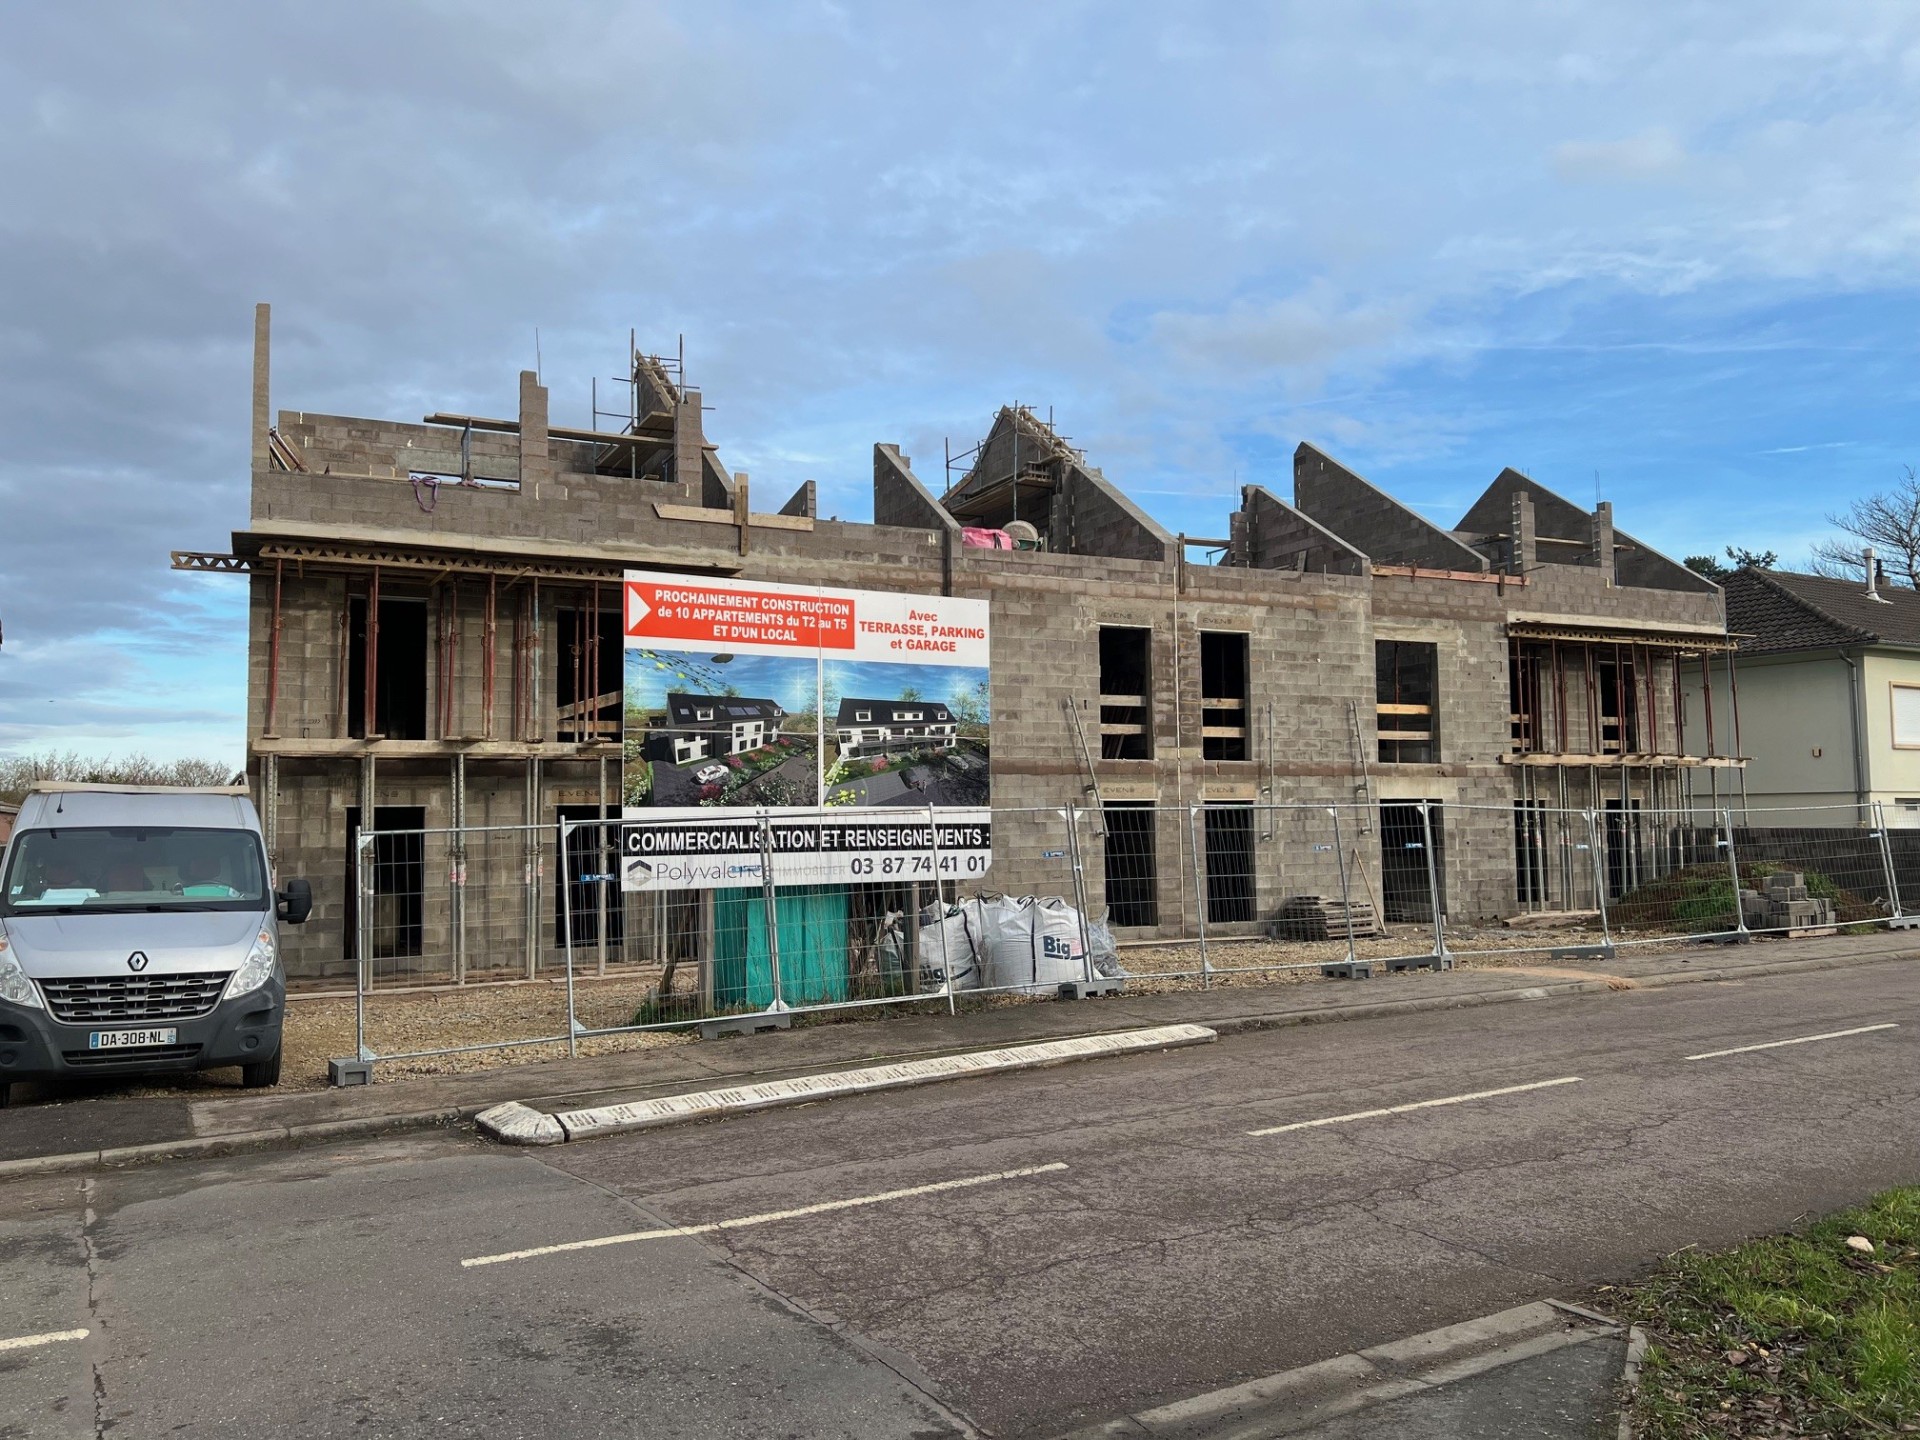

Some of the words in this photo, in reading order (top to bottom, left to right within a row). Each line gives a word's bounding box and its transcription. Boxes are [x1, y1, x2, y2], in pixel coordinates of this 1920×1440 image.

[655, 589, 758, 608] PROCHAINEMENT
[762, 598, 849, 615] CONSTRUCTION
[658, 606, 672, 617] de
[676, 607, 689, 618] 10
[693, 608, 783, 625] APPARTEMENTS
[787, 615, 799, 627] du
[802, 616, 815, 628] T2
[818, 619, 831, 629] au
[834, 617, 847, 630] T5
[909, 610, 938, 622] Avec
[713, 625, 728, 637] ET
[732, 627, 758, 638] D'UN
[761, 628, 797, 641] LOCAL
[859, 621, 928, 638] TERRASSE,
[931, 626, 985, 639] PARKING
[890, 639, 902, 649] et
[906, 639, 956, 652] GARAGE
[628, 830, 815, 851] COMMERCIALISATION
[822, 831, 840, 847] ET
[845, 829, 982, 848] RENSEIGNEMENTS
[779, 865, 846, 878] IMMOBILIER
[851, 858, 874, 875] 03
[882, 857, 905, 873] 87
[911, 856, 932, 873] 74
[939, 856, 958, 872] 41
[967, 855, 985, 872] 01
[1043, 936, 1071, 960] Big
[101, 1031, 165, 1046] DA-308-NL
